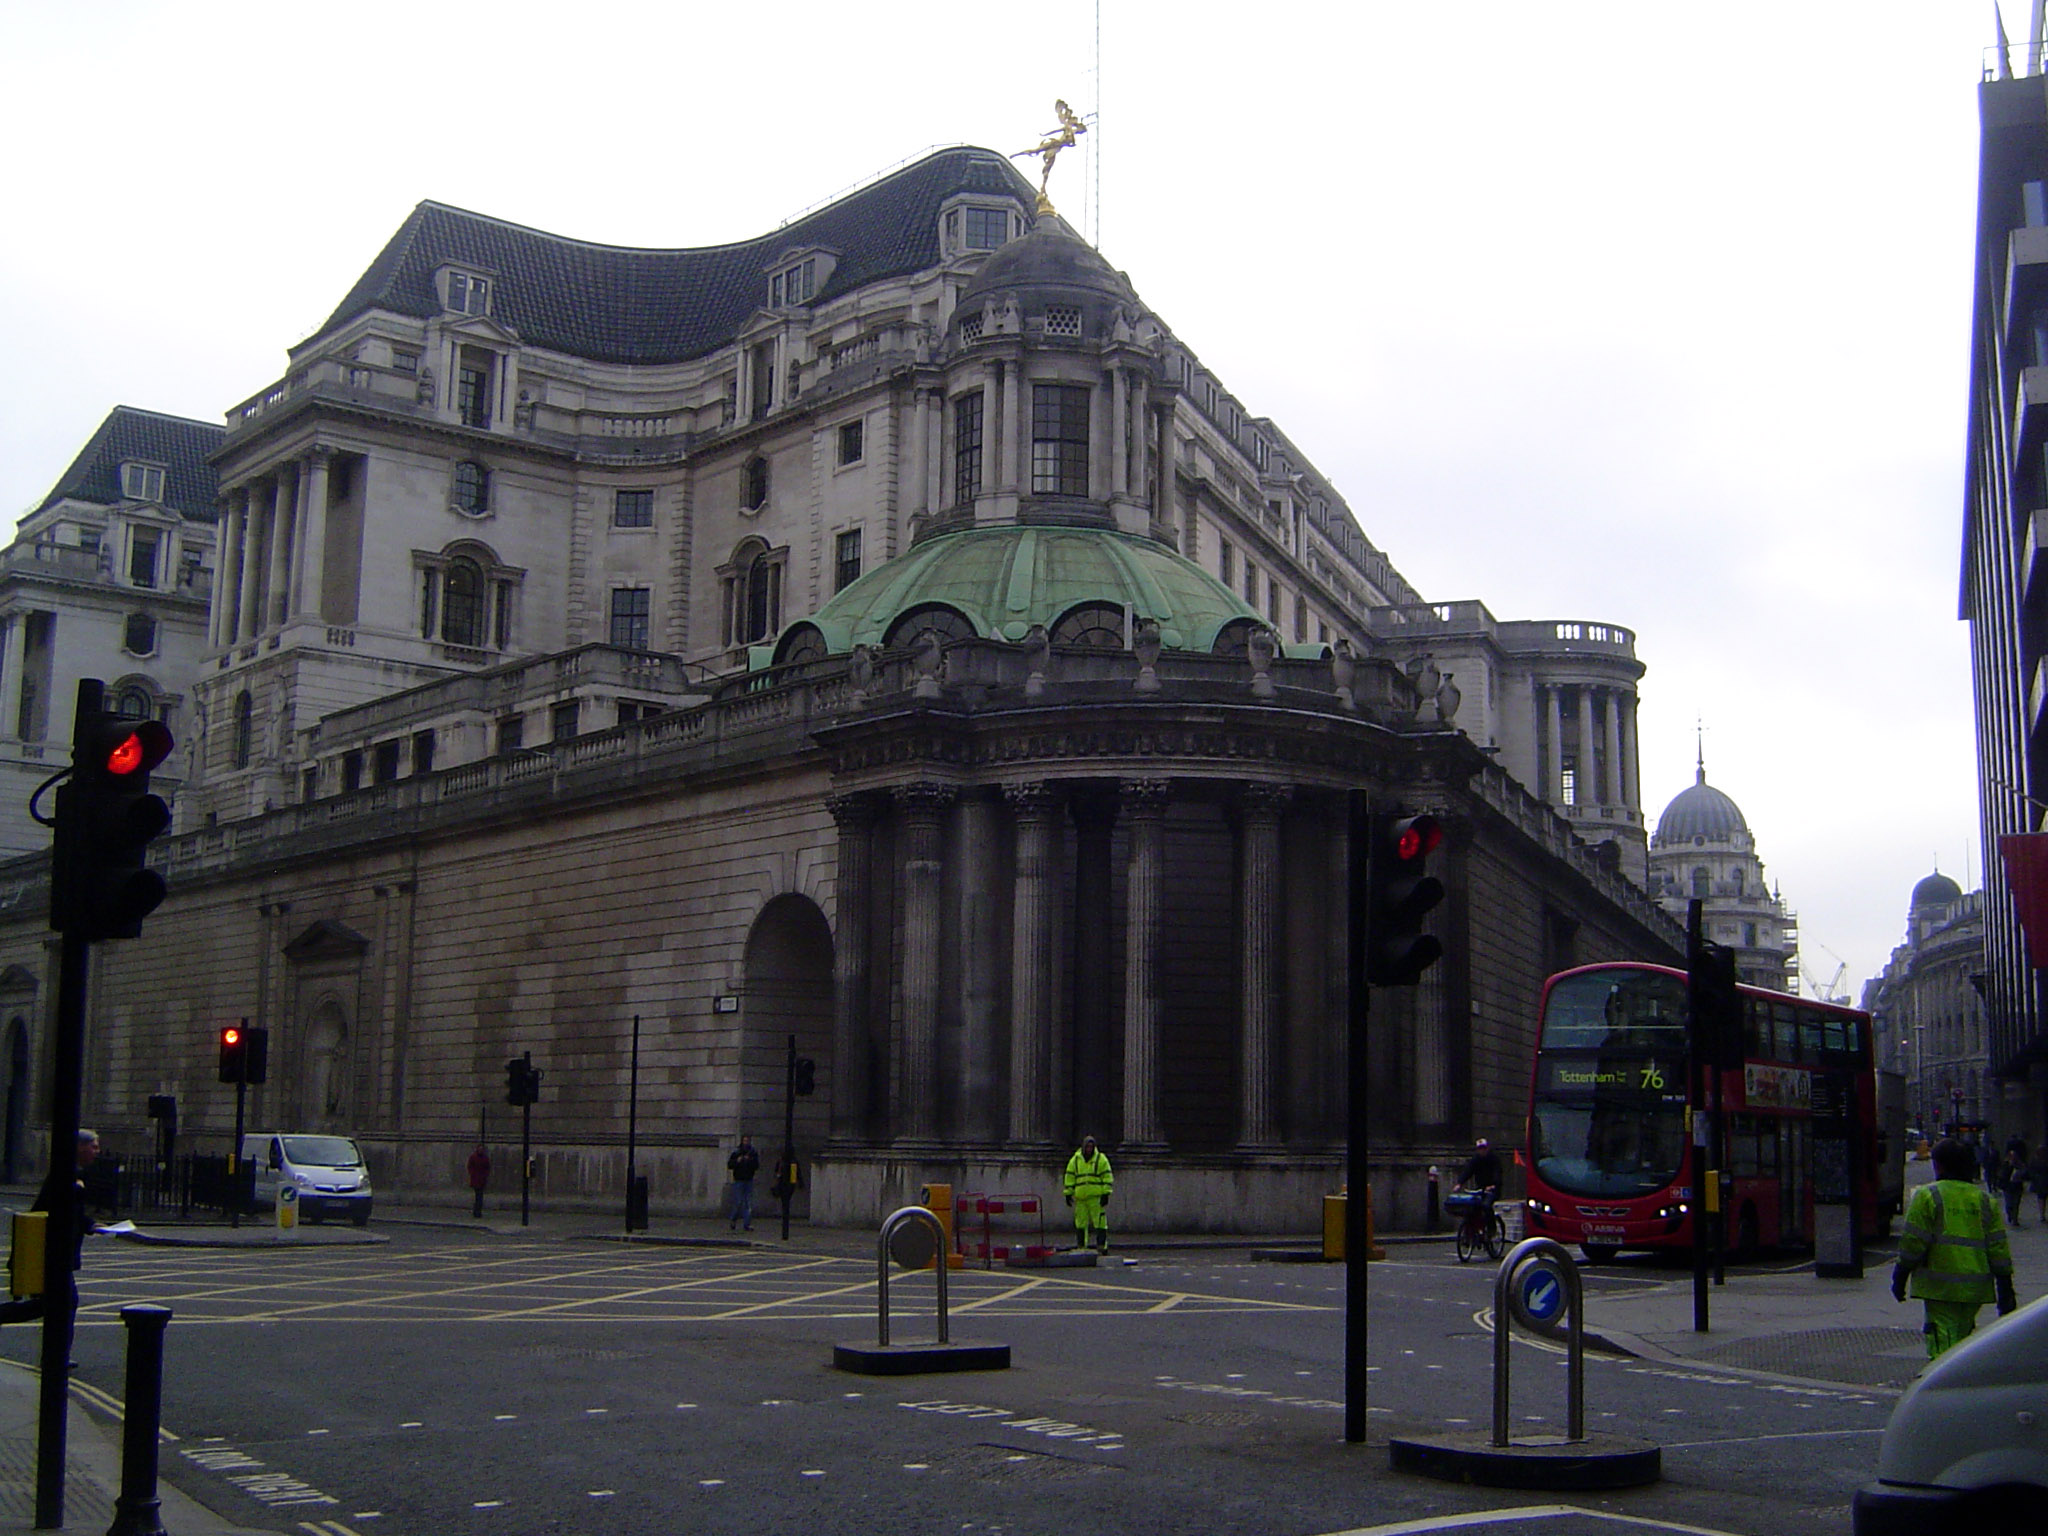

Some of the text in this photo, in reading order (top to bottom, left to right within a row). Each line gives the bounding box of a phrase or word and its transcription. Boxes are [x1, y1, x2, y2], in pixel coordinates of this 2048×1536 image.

[1559, 1069, 1615, 1083] Tottenham
[1640, 1068, 1664, 1089] 76
[897, 1399, 1124, 1440] LOOK LEFT
[180, 1446, 340, 1507] LOOK RIGHT
